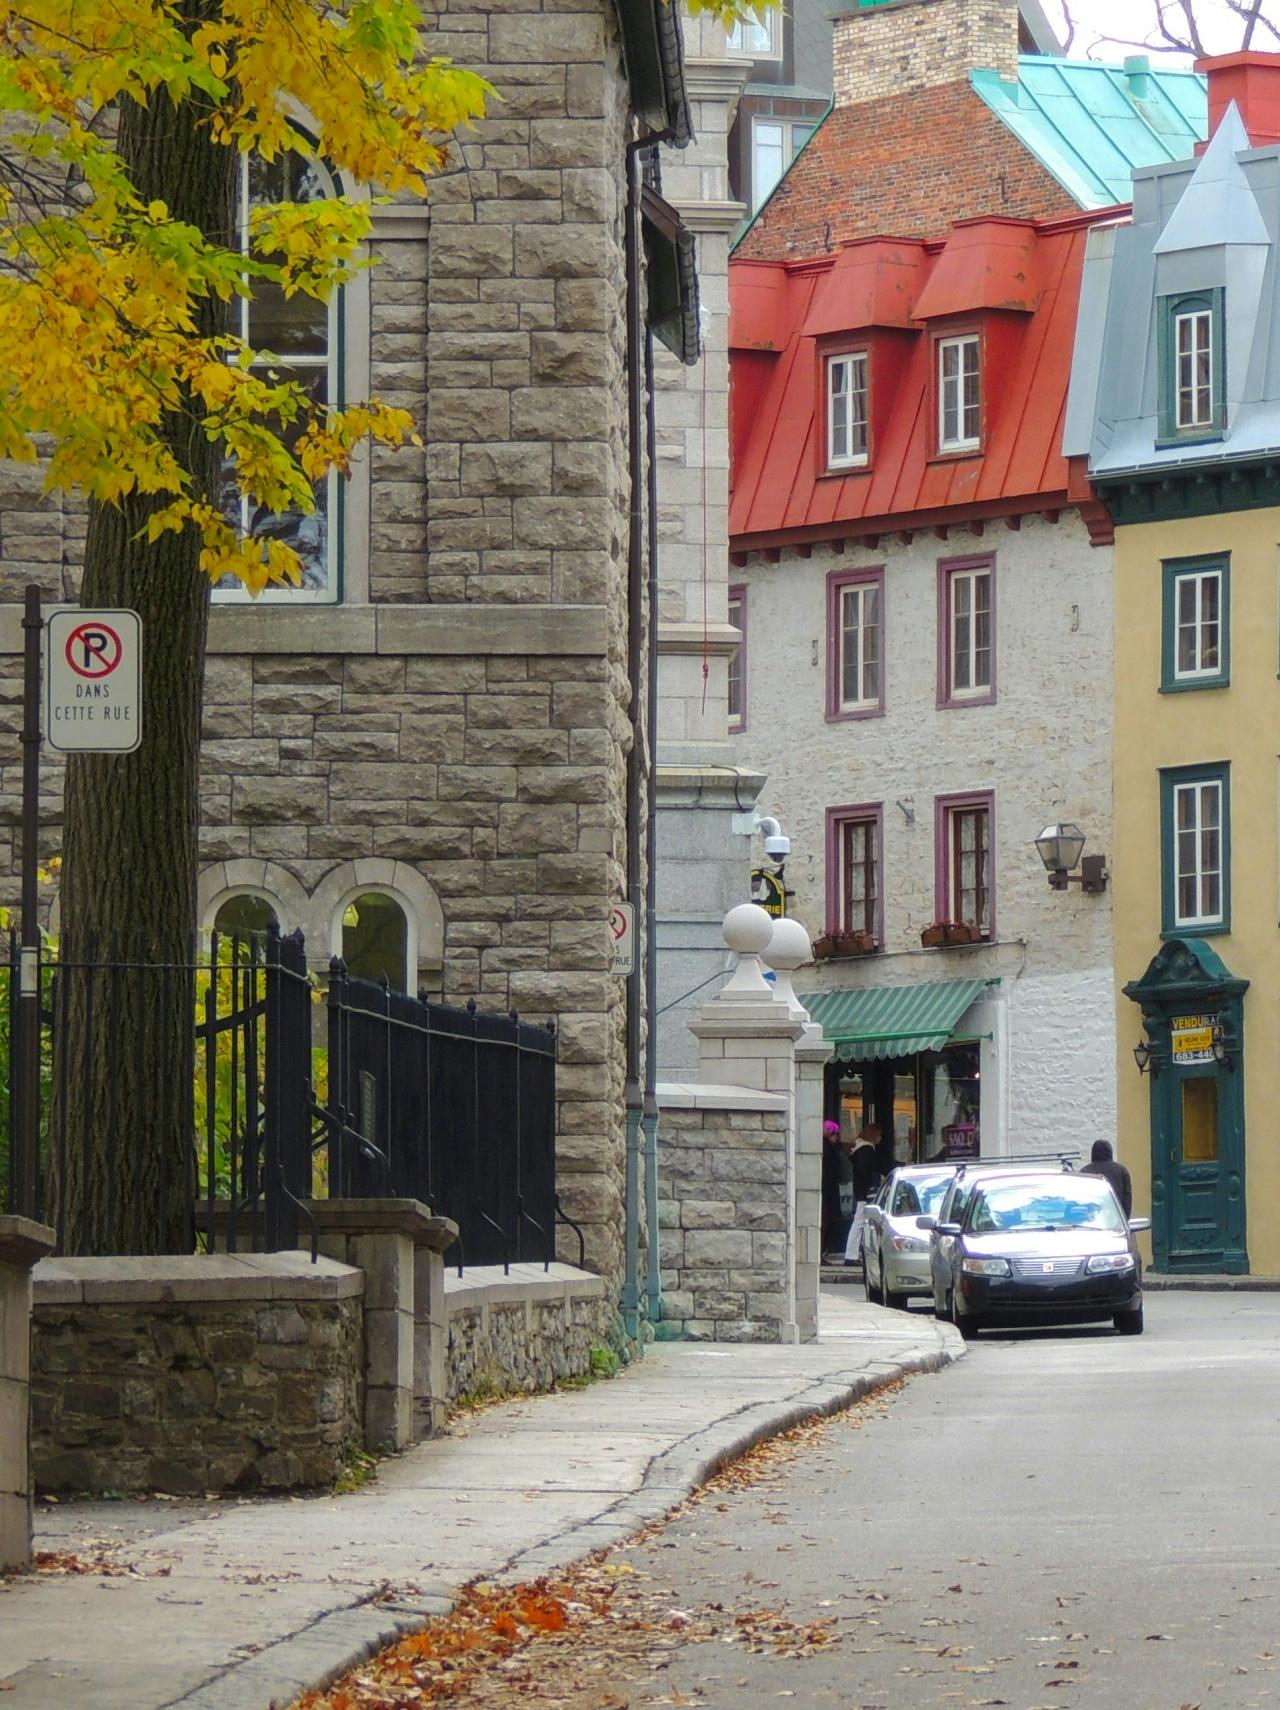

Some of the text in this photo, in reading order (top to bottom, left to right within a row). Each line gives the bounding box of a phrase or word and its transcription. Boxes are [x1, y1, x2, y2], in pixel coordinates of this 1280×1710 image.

[76, 684, 110, 698] DANS
[55, 706, 131, 721] CETTE RUE
[615, 956, 632, 966] RUE
[1172, 1016, 1204, 1030] VENDU
